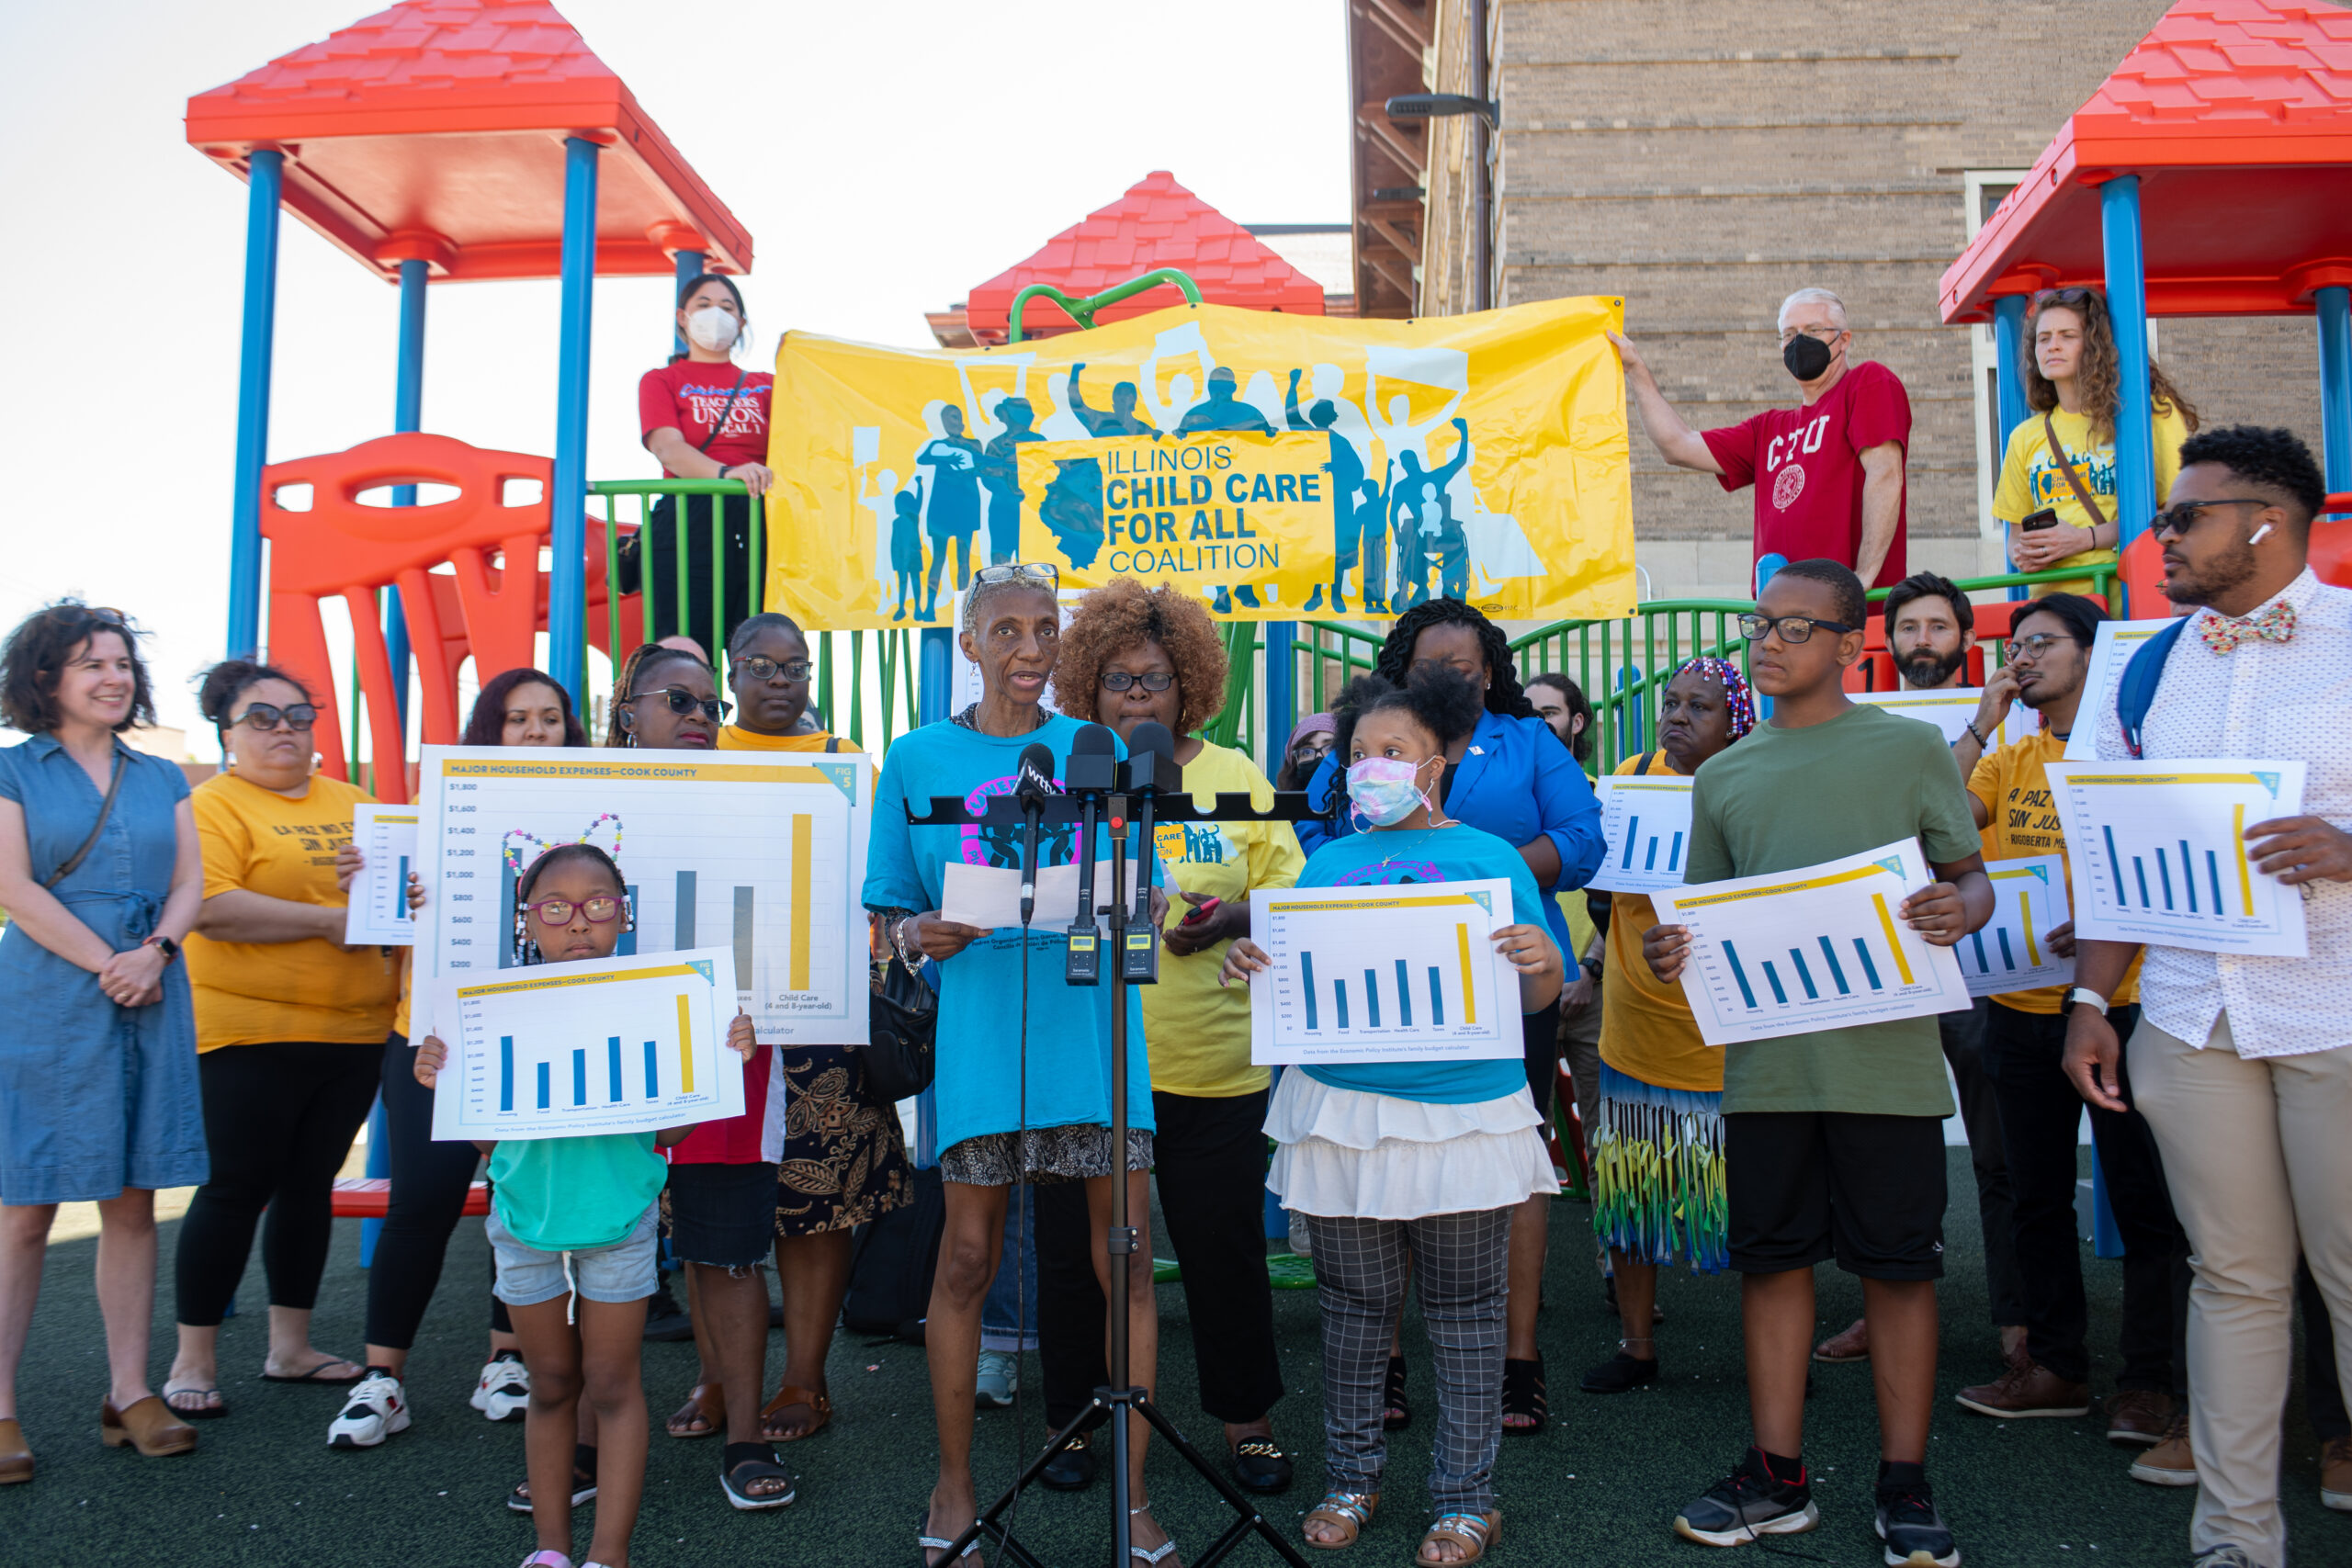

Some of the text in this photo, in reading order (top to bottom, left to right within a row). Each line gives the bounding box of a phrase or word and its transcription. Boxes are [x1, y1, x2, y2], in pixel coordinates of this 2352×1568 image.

[693, 407, 765, 424] UNION
[708, 423, 752, 434] LCAL
[1767, 415, 1830, 472] CTU
[1108, 446, 1232, 475] ILLINOIS
[1106, 473, 1321, 511] CHILD CARE
[1108, 508, 1256, 546] FOR ALL
[1109, 544, 1279, 573] COALITION
[491, 766, 557, 774] HOUSEHOLD
[653, 768, 697, 777] COUNTY
[843, 777, 851, 788] 5
[2021, 790, 2051, 807] PAZ
[2009, 809, 2032, 828] SIN
[1156, 833, 1182, 842] CARE
[2011, 834, 2051, 848] RIGOBERTA
[447, 849, 475, 857] $1,200
[1698, 895, 1733, 904] HOUSEHOLD
[1783, 883, 1808, 891] COUNTY
[451, 938, 472, 946] $400
[487, 983, 528, 993] HOUSEHOLD
